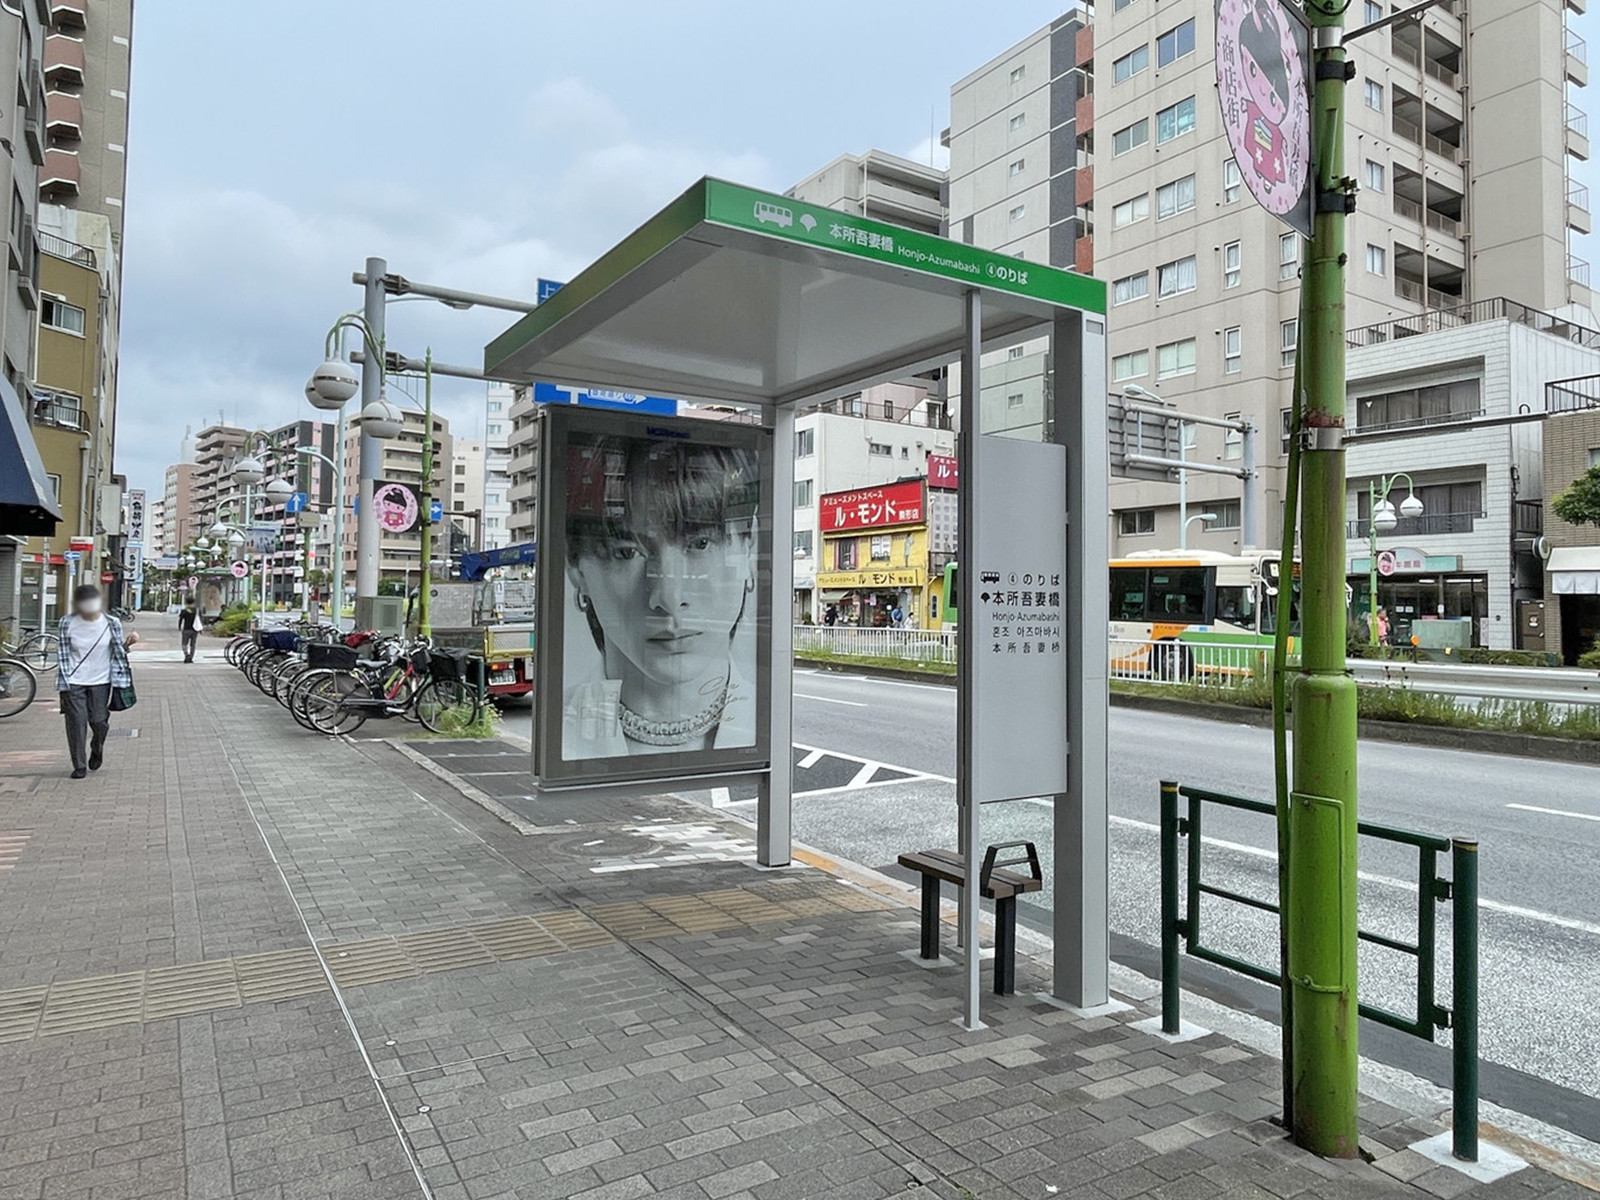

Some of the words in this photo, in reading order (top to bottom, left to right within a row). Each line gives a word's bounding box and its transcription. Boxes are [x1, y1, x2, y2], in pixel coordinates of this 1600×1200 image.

[1221, 34, 1240, 129] 商店街
[829, 223, 894, 253] 本所吾妻橋
[897, 245, 980, 275] Honjo-Azumabashi
[824, 490, 883, 506] アミューズメントスペース
[992, 590, 1060, 607] 本所吾妻橋
[992, 626, 1010, 638] 혼조
[1017, 626, 1060, 638] 아즈마바시
